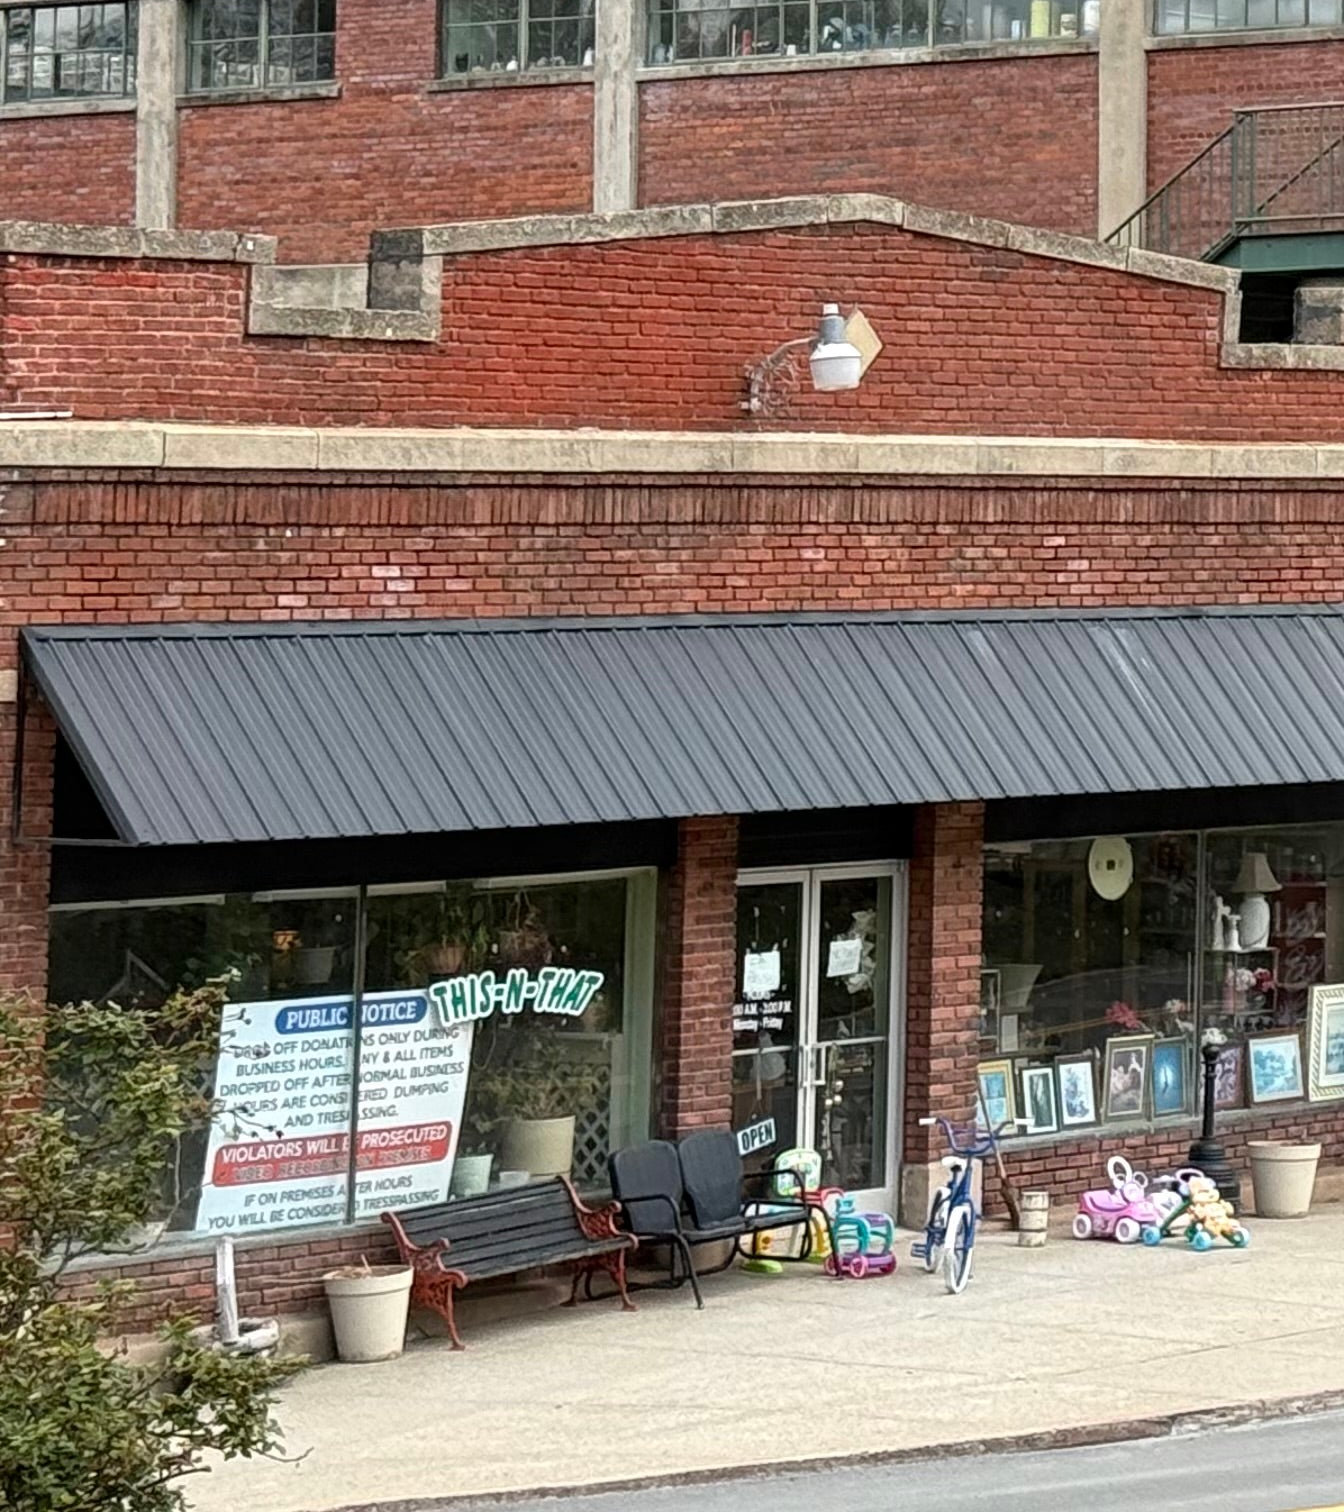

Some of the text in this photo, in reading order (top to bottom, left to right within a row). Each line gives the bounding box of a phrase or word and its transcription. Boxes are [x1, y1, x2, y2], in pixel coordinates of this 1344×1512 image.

[431, 967, 603, 1026] THIS-N-THAT
[285, 1006, 348, 1030] PUBLIC
[273, 1041, 299, 1055] OFF
[301, 1033, 375, 1053] DONATINS
[378, 1031, 412, 1046] ONLY
[413, 1026, 461, 1042] DURING
[236, 1059, 296, 1077] BUSINESS
[359, 1051, 381, 1067] NY
[382, 1050, 391, 1064] &
[393, 1048, 417, 1063] ALL
[419, 1044, 454, 1060] ITEMS
[219, 1060, 465, 1097] DROPPED OFF AFTER ORMAL BUSINESS
[280, 1094, 308, 1110] ARE
[309, 1087, 388, 1108] CONSIERED
[393, 1080, 450, 1100] DUMPING
[283, 1114, 314, 1129] AND
[741, 1121, 773, 1151] OPEN
[221, 1140, 304, 1165] VIOLATORS
[306, 1137, 340, 1157] WILL
[361, 1124, 448, 1150] PROSECUTED
[244, 1174, 413, 1208] IF ON PREMISES ATER HOURS
[208, 1188, 440, 1229] YOU WILL BE CONSIDERD TRESSPASSING
